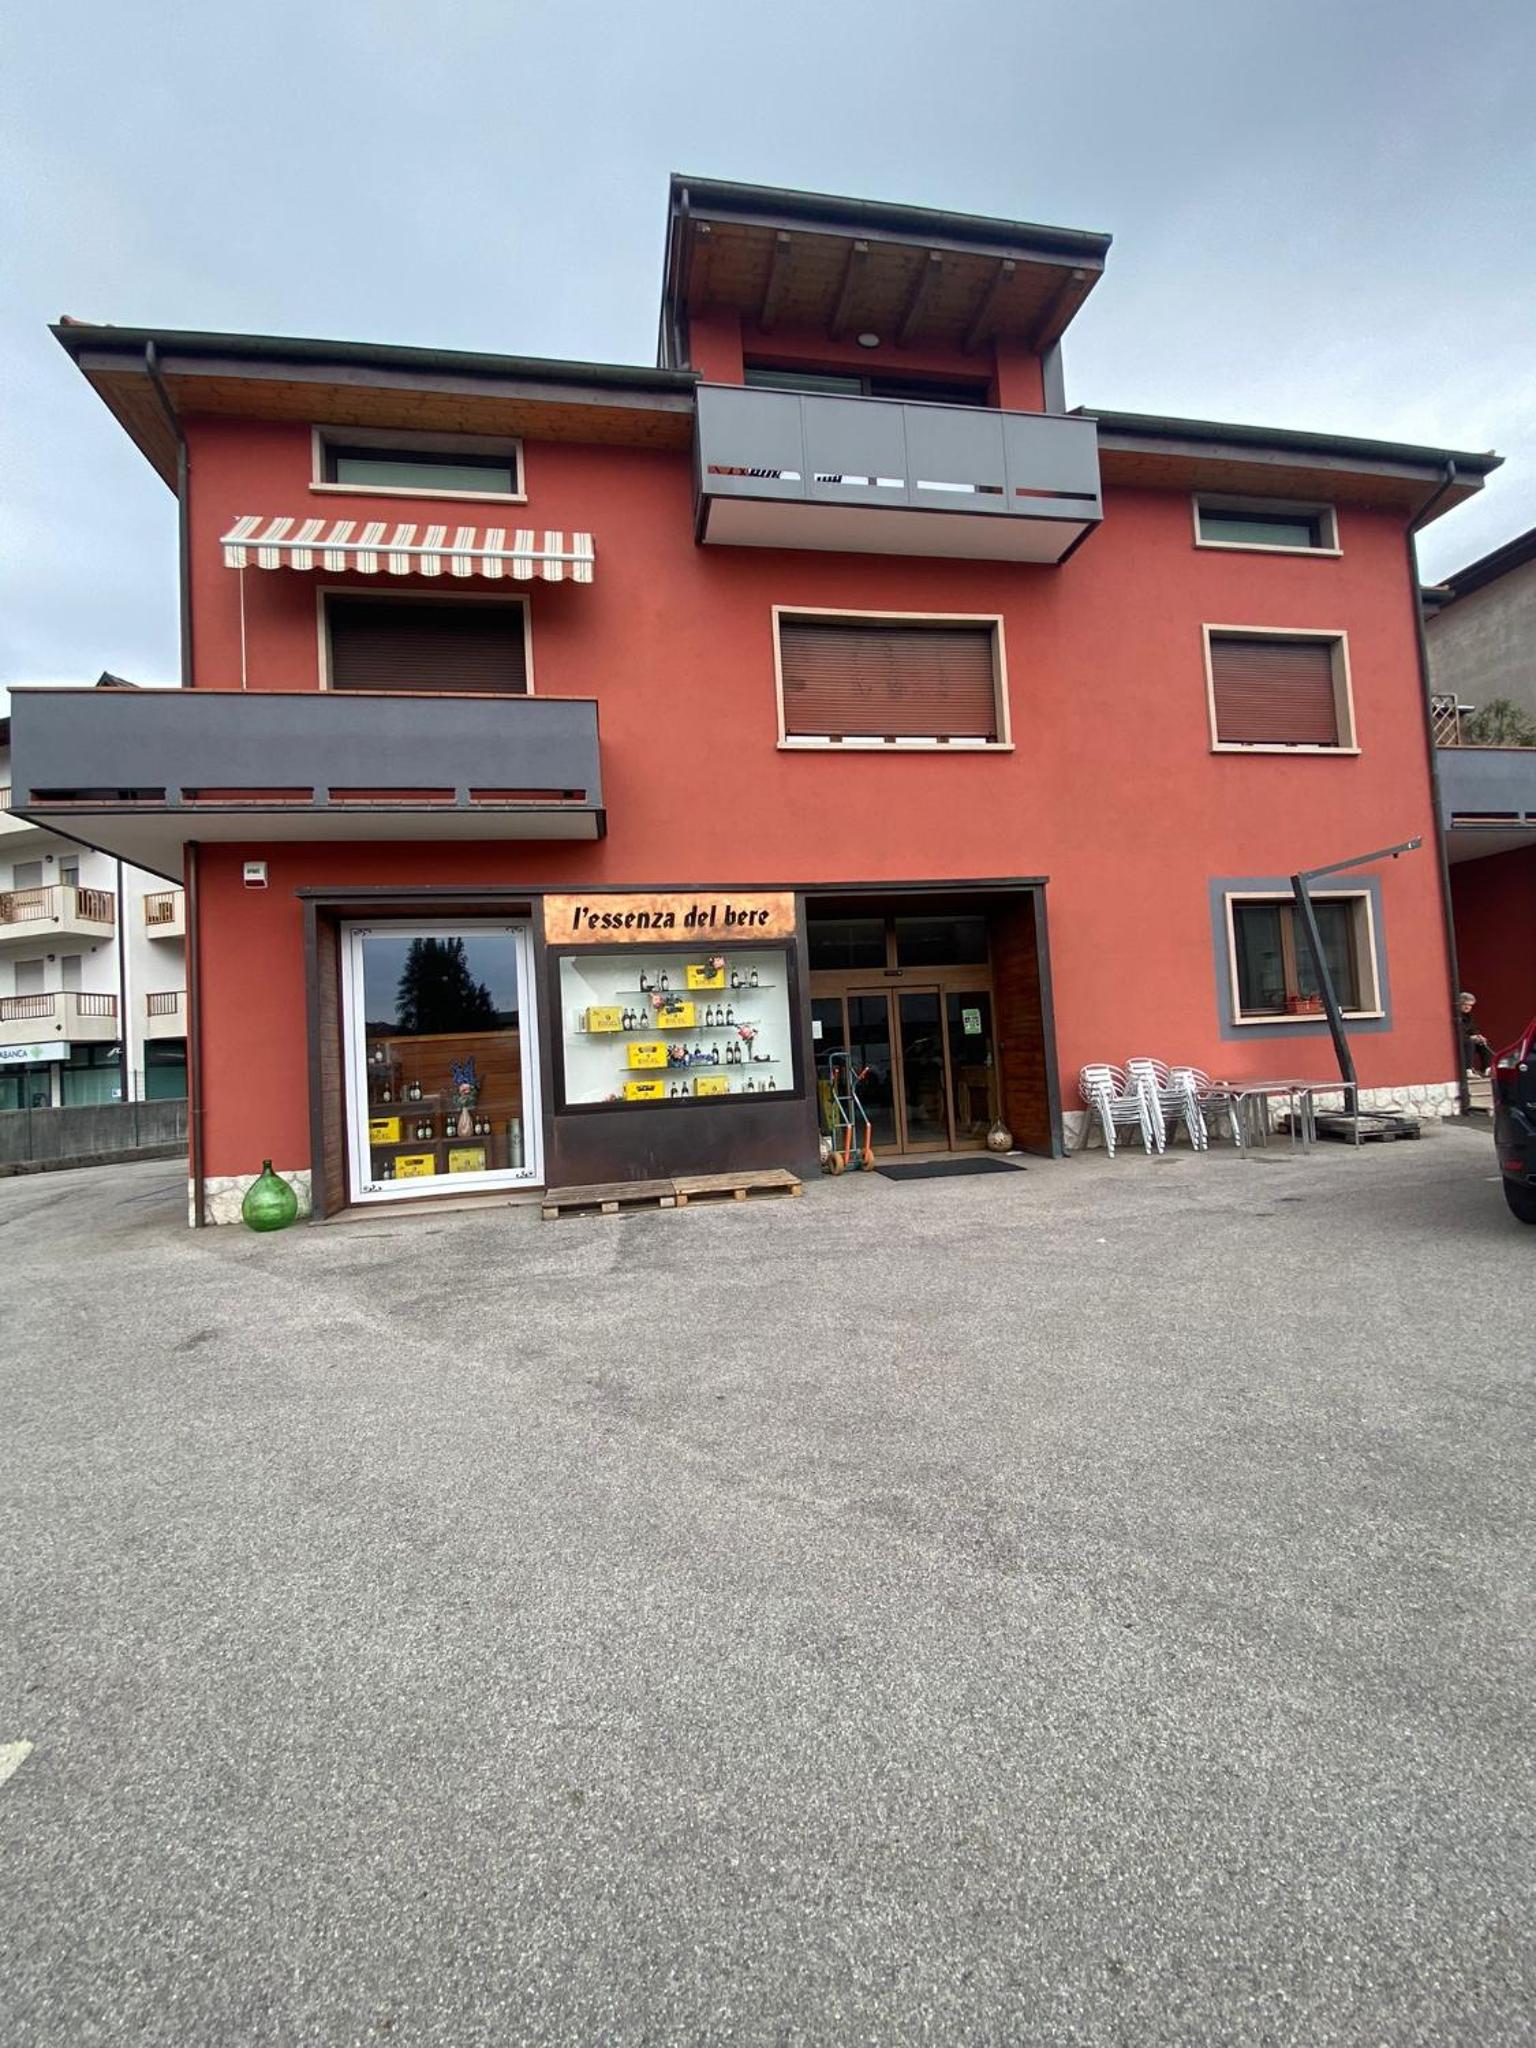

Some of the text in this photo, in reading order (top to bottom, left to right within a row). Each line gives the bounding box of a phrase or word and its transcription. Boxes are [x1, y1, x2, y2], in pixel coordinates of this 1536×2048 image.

[573, 904, 770, 930] l'essenza del bere
